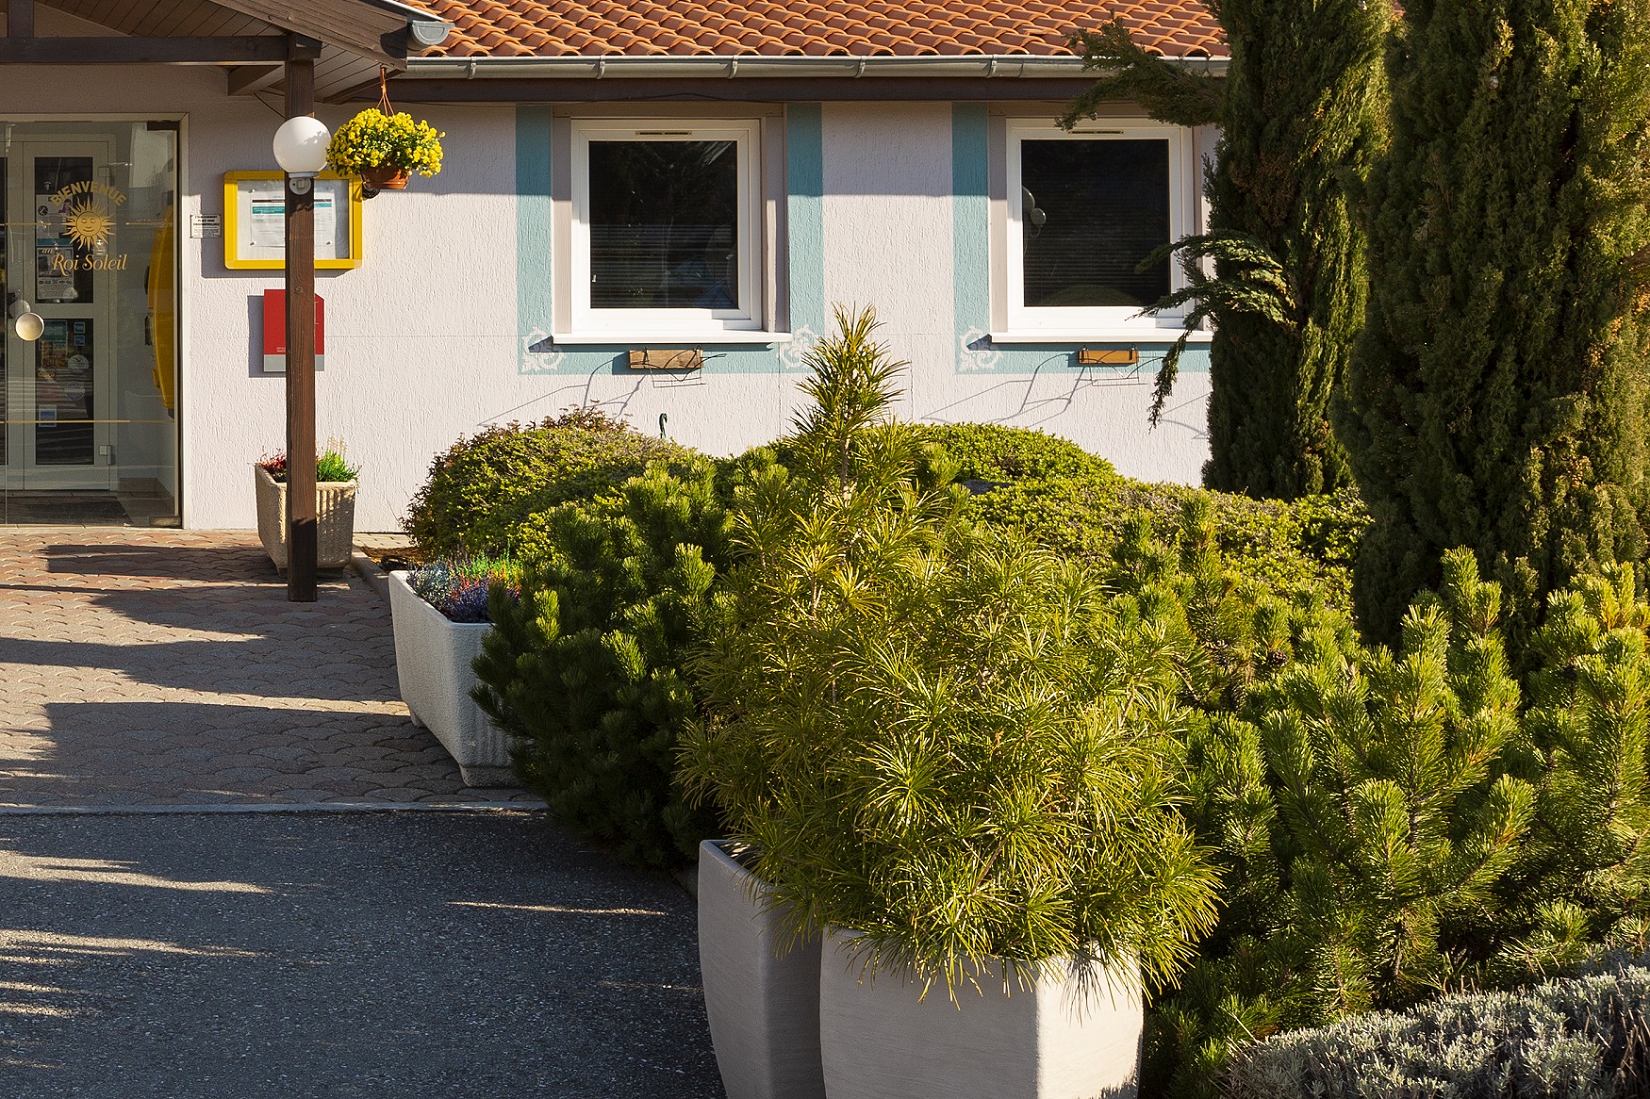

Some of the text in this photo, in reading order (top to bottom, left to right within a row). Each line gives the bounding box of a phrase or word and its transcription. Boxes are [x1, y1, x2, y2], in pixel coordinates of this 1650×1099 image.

[50, 181, 127, 206] BIENVENUE
[52, 252, 127, 277] Roi Soleil
